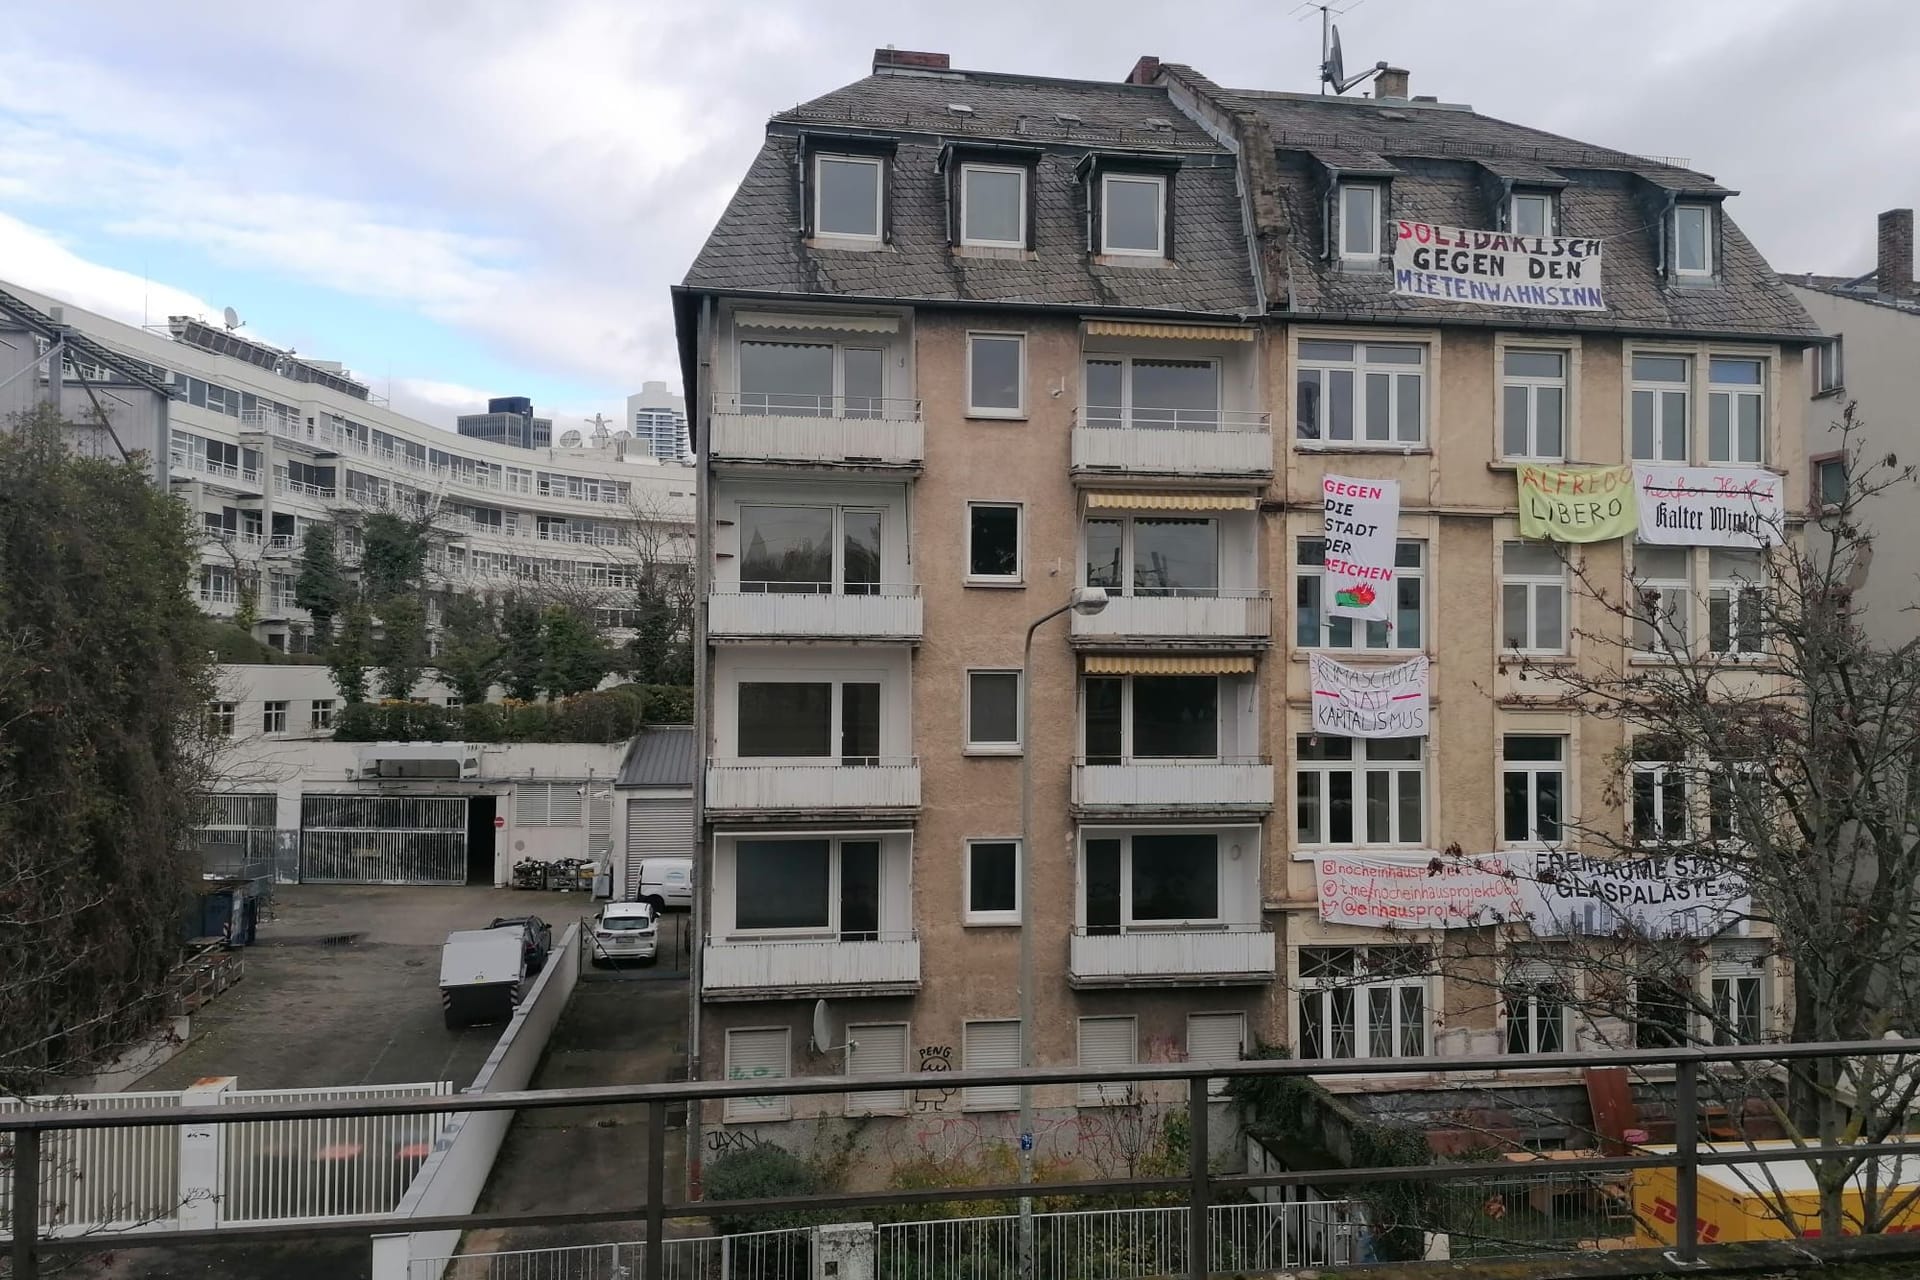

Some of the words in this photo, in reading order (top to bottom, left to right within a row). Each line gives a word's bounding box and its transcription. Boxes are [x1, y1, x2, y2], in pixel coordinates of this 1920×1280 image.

[1398, 220, 1600, 258] SOLIDARISCH
[1413, 247, 1504, 278] GEGEN
[1528, 257, 1581, 280] DEN
[1396, 268, 1603, 308] MIETENWAHNSINN
[1324, 479, 1382, 500] GEGEN
[1522, 467, 1633, 496] ALFREDO
[1325, 498, 1354, 517] DIE
[1531, 497, 1622, 525] LIBERO
[1656, 502, 1703, 531] Kalter
[1709, 506, 1760, 534] Winter
[1324, 517, 1378, 538] STADT
[1324, 538, 1352, 555] DER
[1324, 557, 1393, 582] REICHEN
[1340, 688, 1390, 710] STATT
[1319, 704, 1423, 732] KAPITALISMUS
[919, 1046, 952, 1060] PENG
